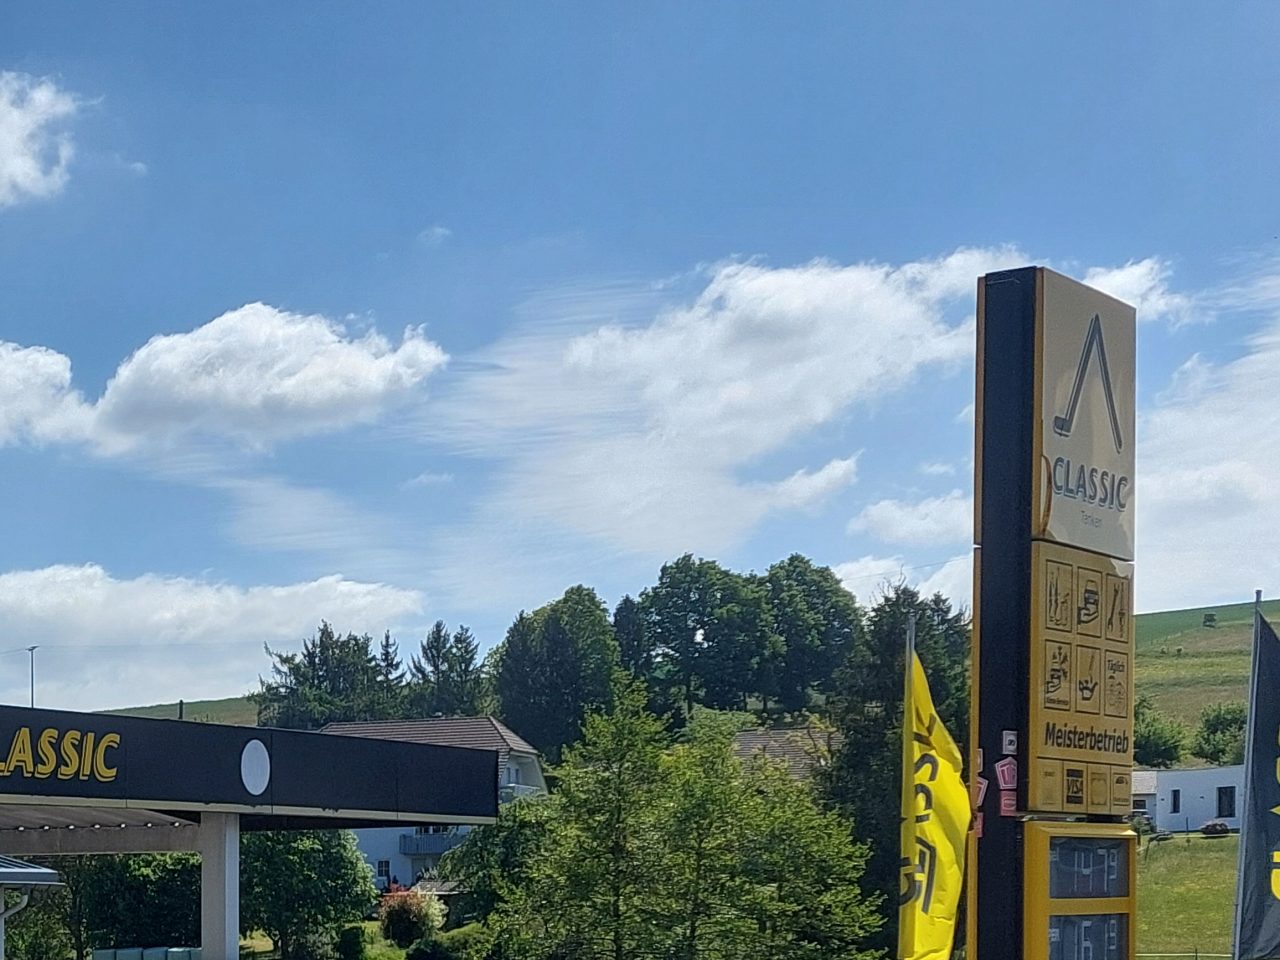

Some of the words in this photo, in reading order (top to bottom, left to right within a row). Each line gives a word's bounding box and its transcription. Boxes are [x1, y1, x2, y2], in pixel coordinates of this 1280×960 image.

[1053, 457, 1128, 512] CLASSIC
[1107, 660, 1126, 674] Täglich
[1045, 721, 1129, 754] Meisterbetrieb
[1066, 778, 1084, 795] VISA
